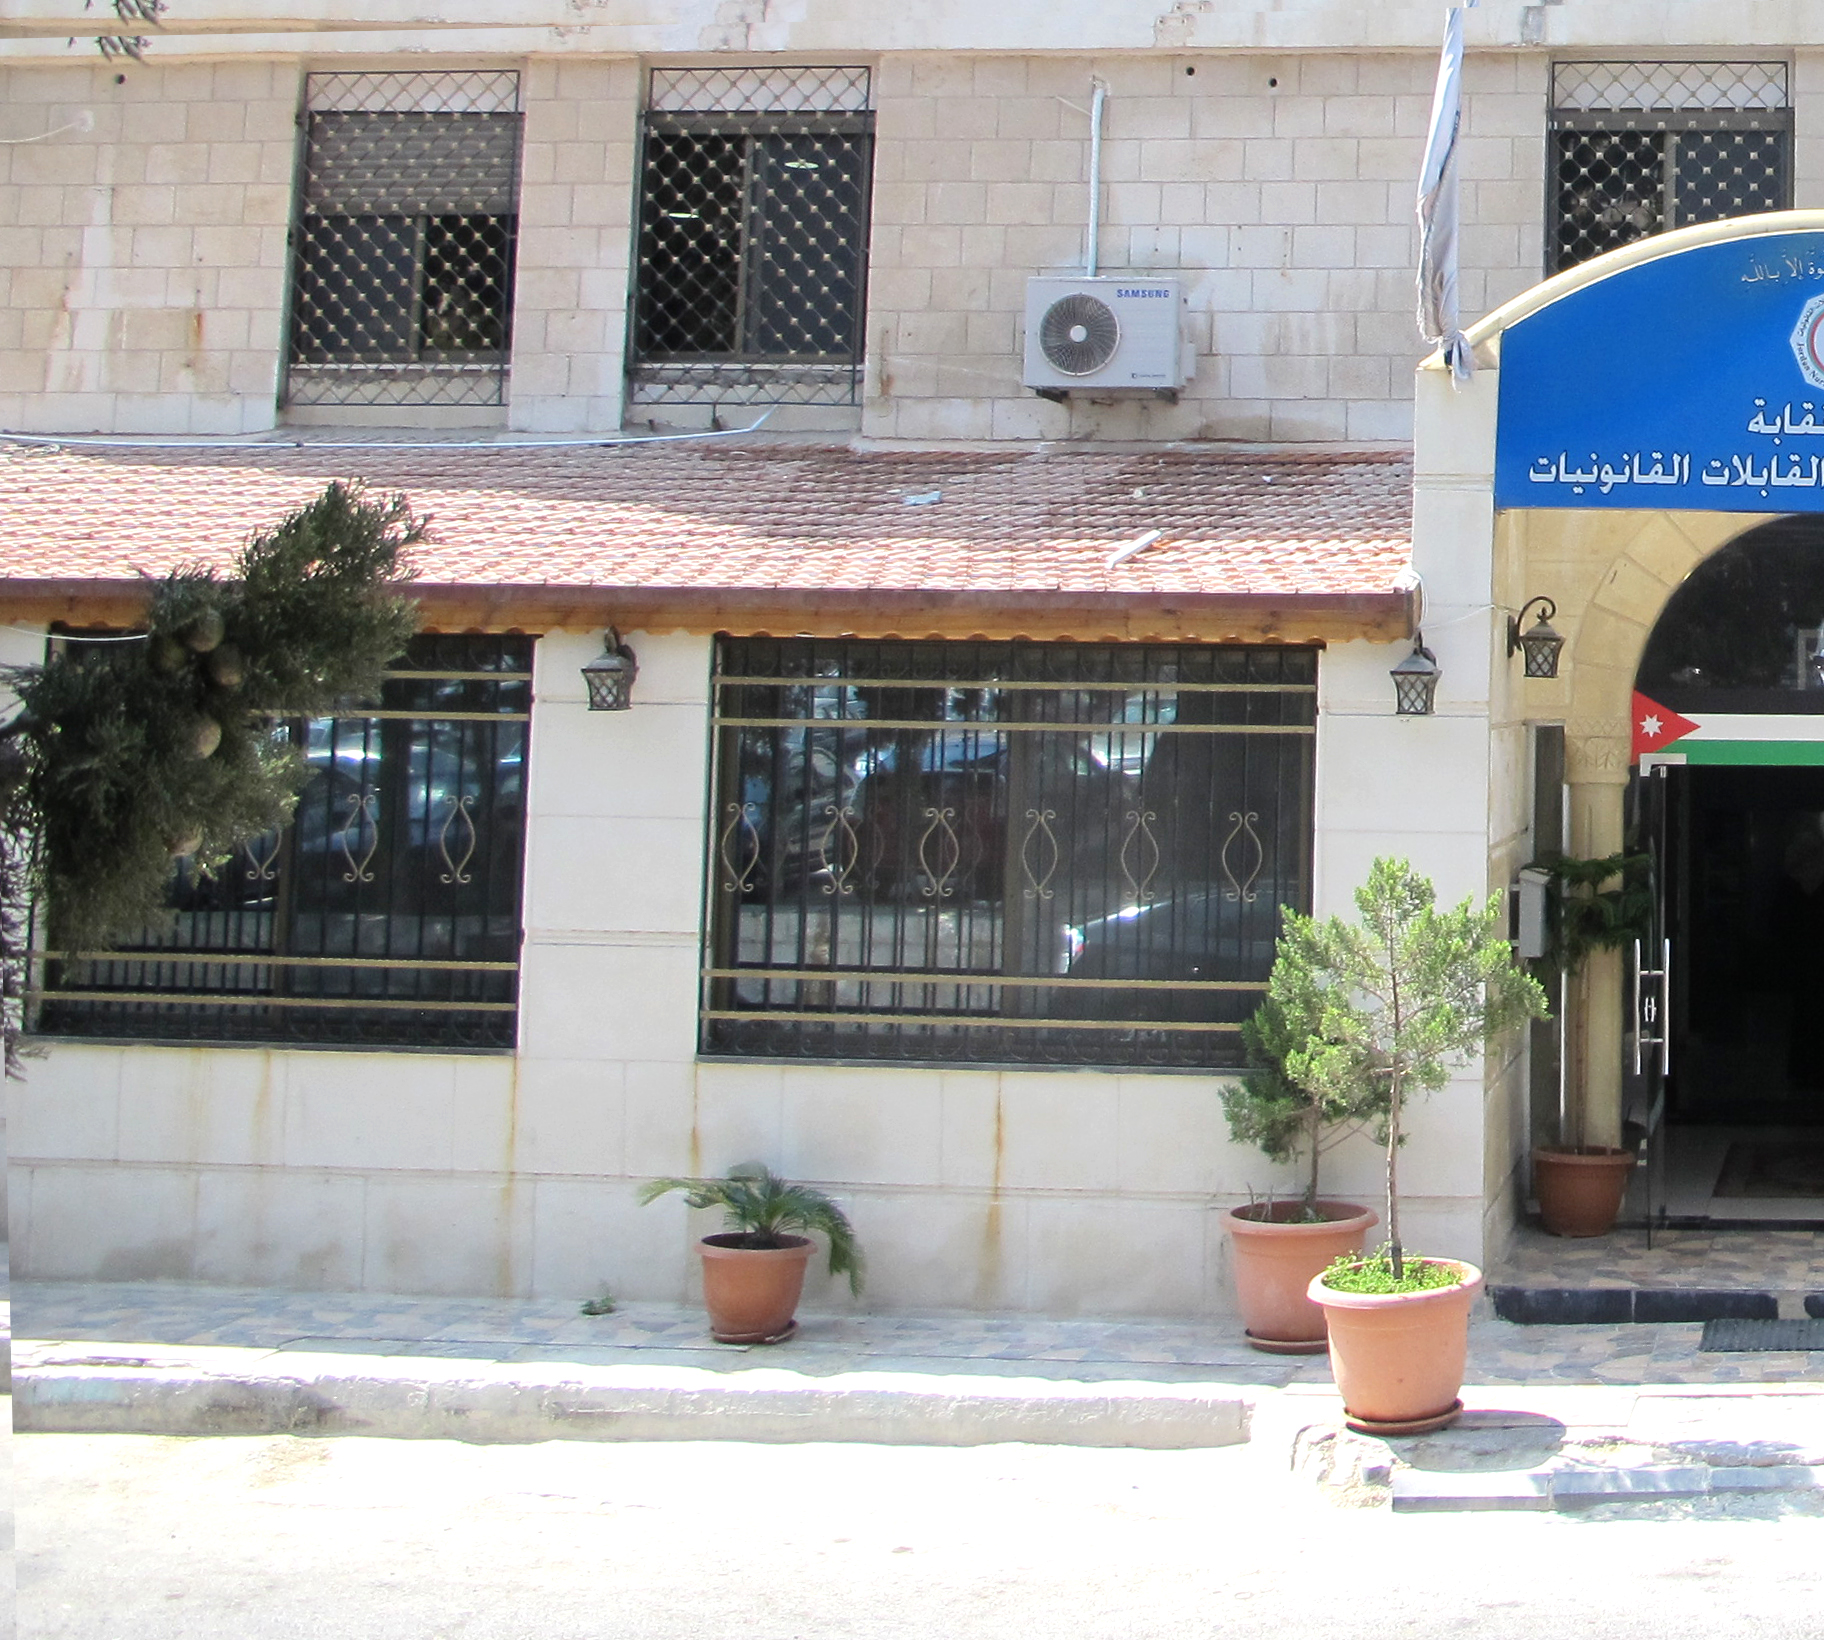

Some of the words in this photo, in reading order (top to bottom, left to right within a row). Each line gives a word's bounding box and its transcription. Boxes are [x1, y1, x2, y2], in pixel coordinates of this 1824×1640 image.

[1117, 289, 1170, 298] SAMSUNG
[1797, 343, 1811, 371] Jordan
[1528, 450, 1692, 494] القانونيات
